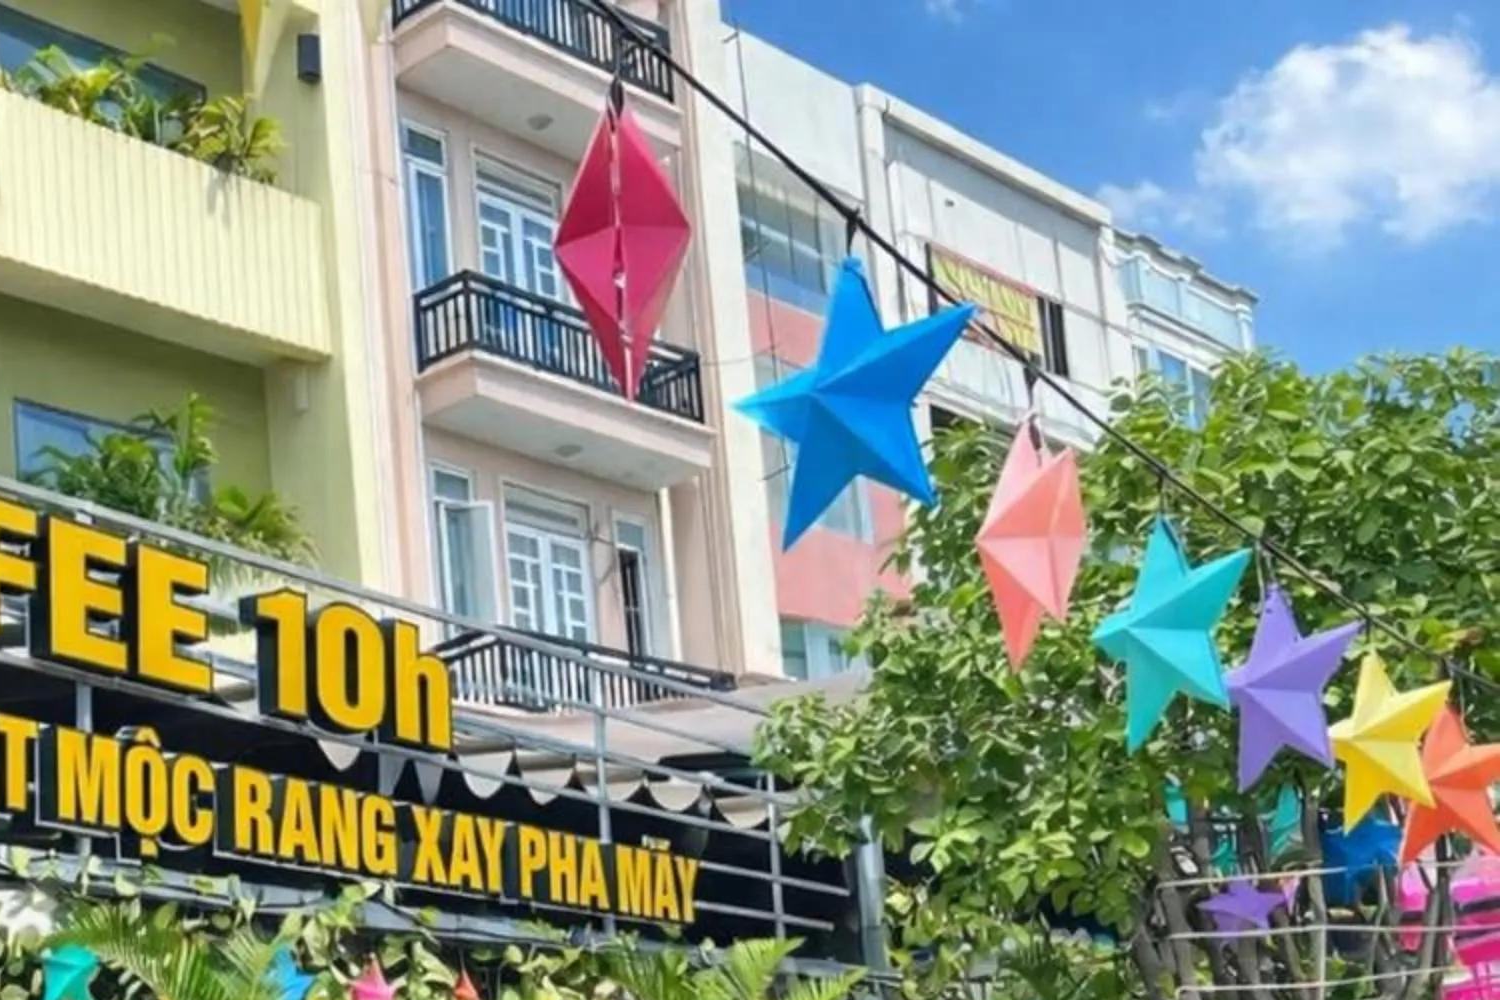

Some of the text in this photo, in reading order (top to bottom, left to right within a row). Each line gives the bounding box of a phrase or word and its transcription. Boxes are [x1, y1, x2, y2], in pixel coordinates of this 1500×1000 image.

[255, 588, 452, 751] 10h
[56, 726, 216, 857] MỘC
[233, 764, 398, 876] RANG
[410, 803, 506, 893] XAY
[517, 824, 610, 910] PHA
